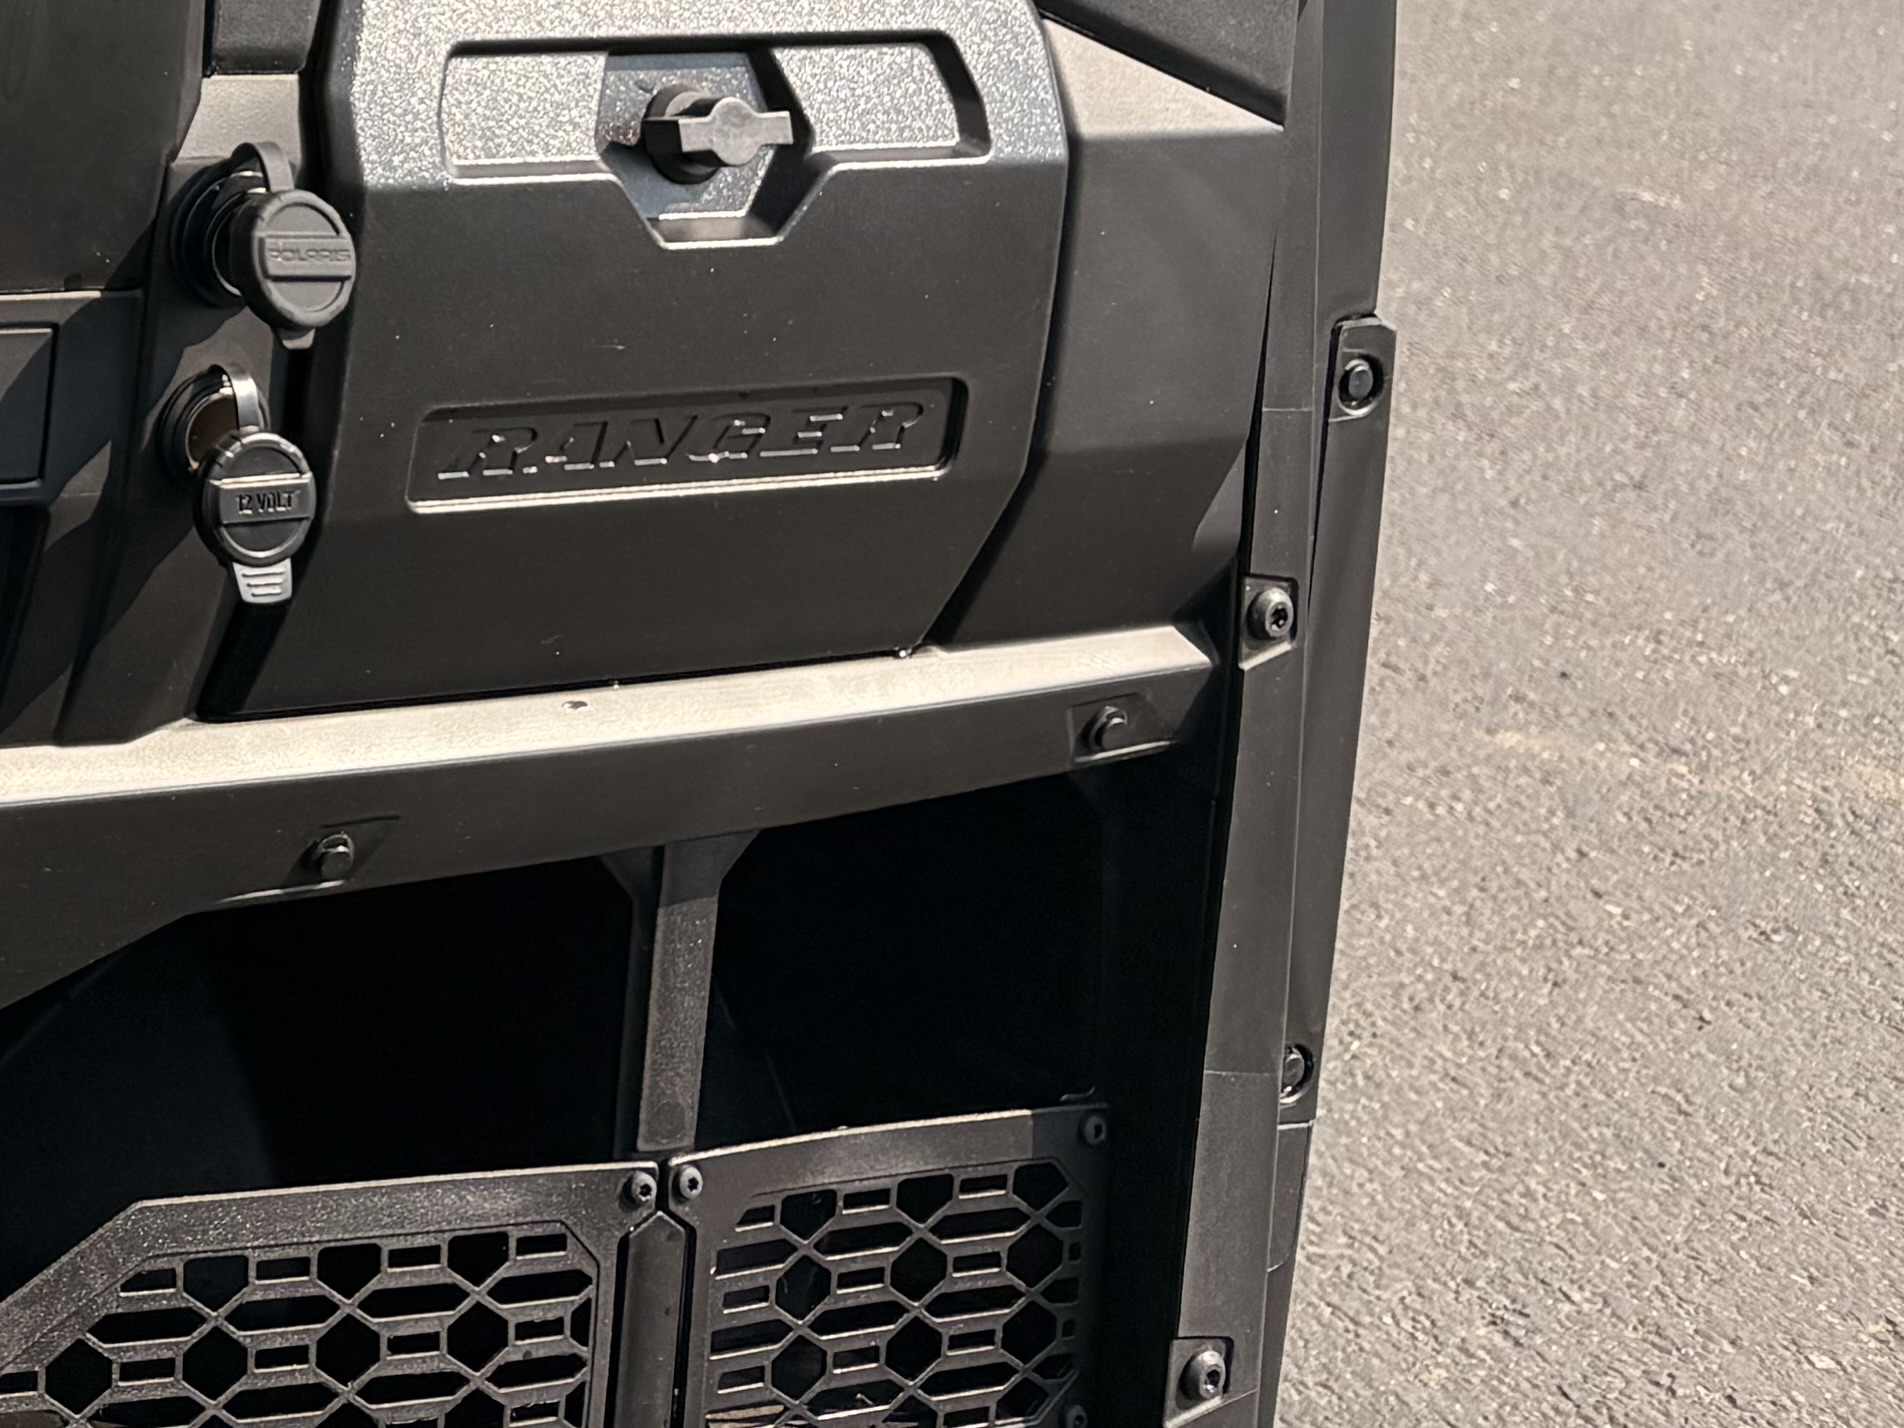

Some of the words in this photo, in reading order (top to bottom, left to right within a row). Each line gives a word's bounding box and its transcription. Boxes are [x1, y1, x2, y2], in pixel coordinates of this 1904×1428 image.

[267, 247, 352, 263] POLARIS
[438, 402, 925, 480] RANGER
[236, 493, 254, 514] 12
[257, 489, 297, 513] VOLT
